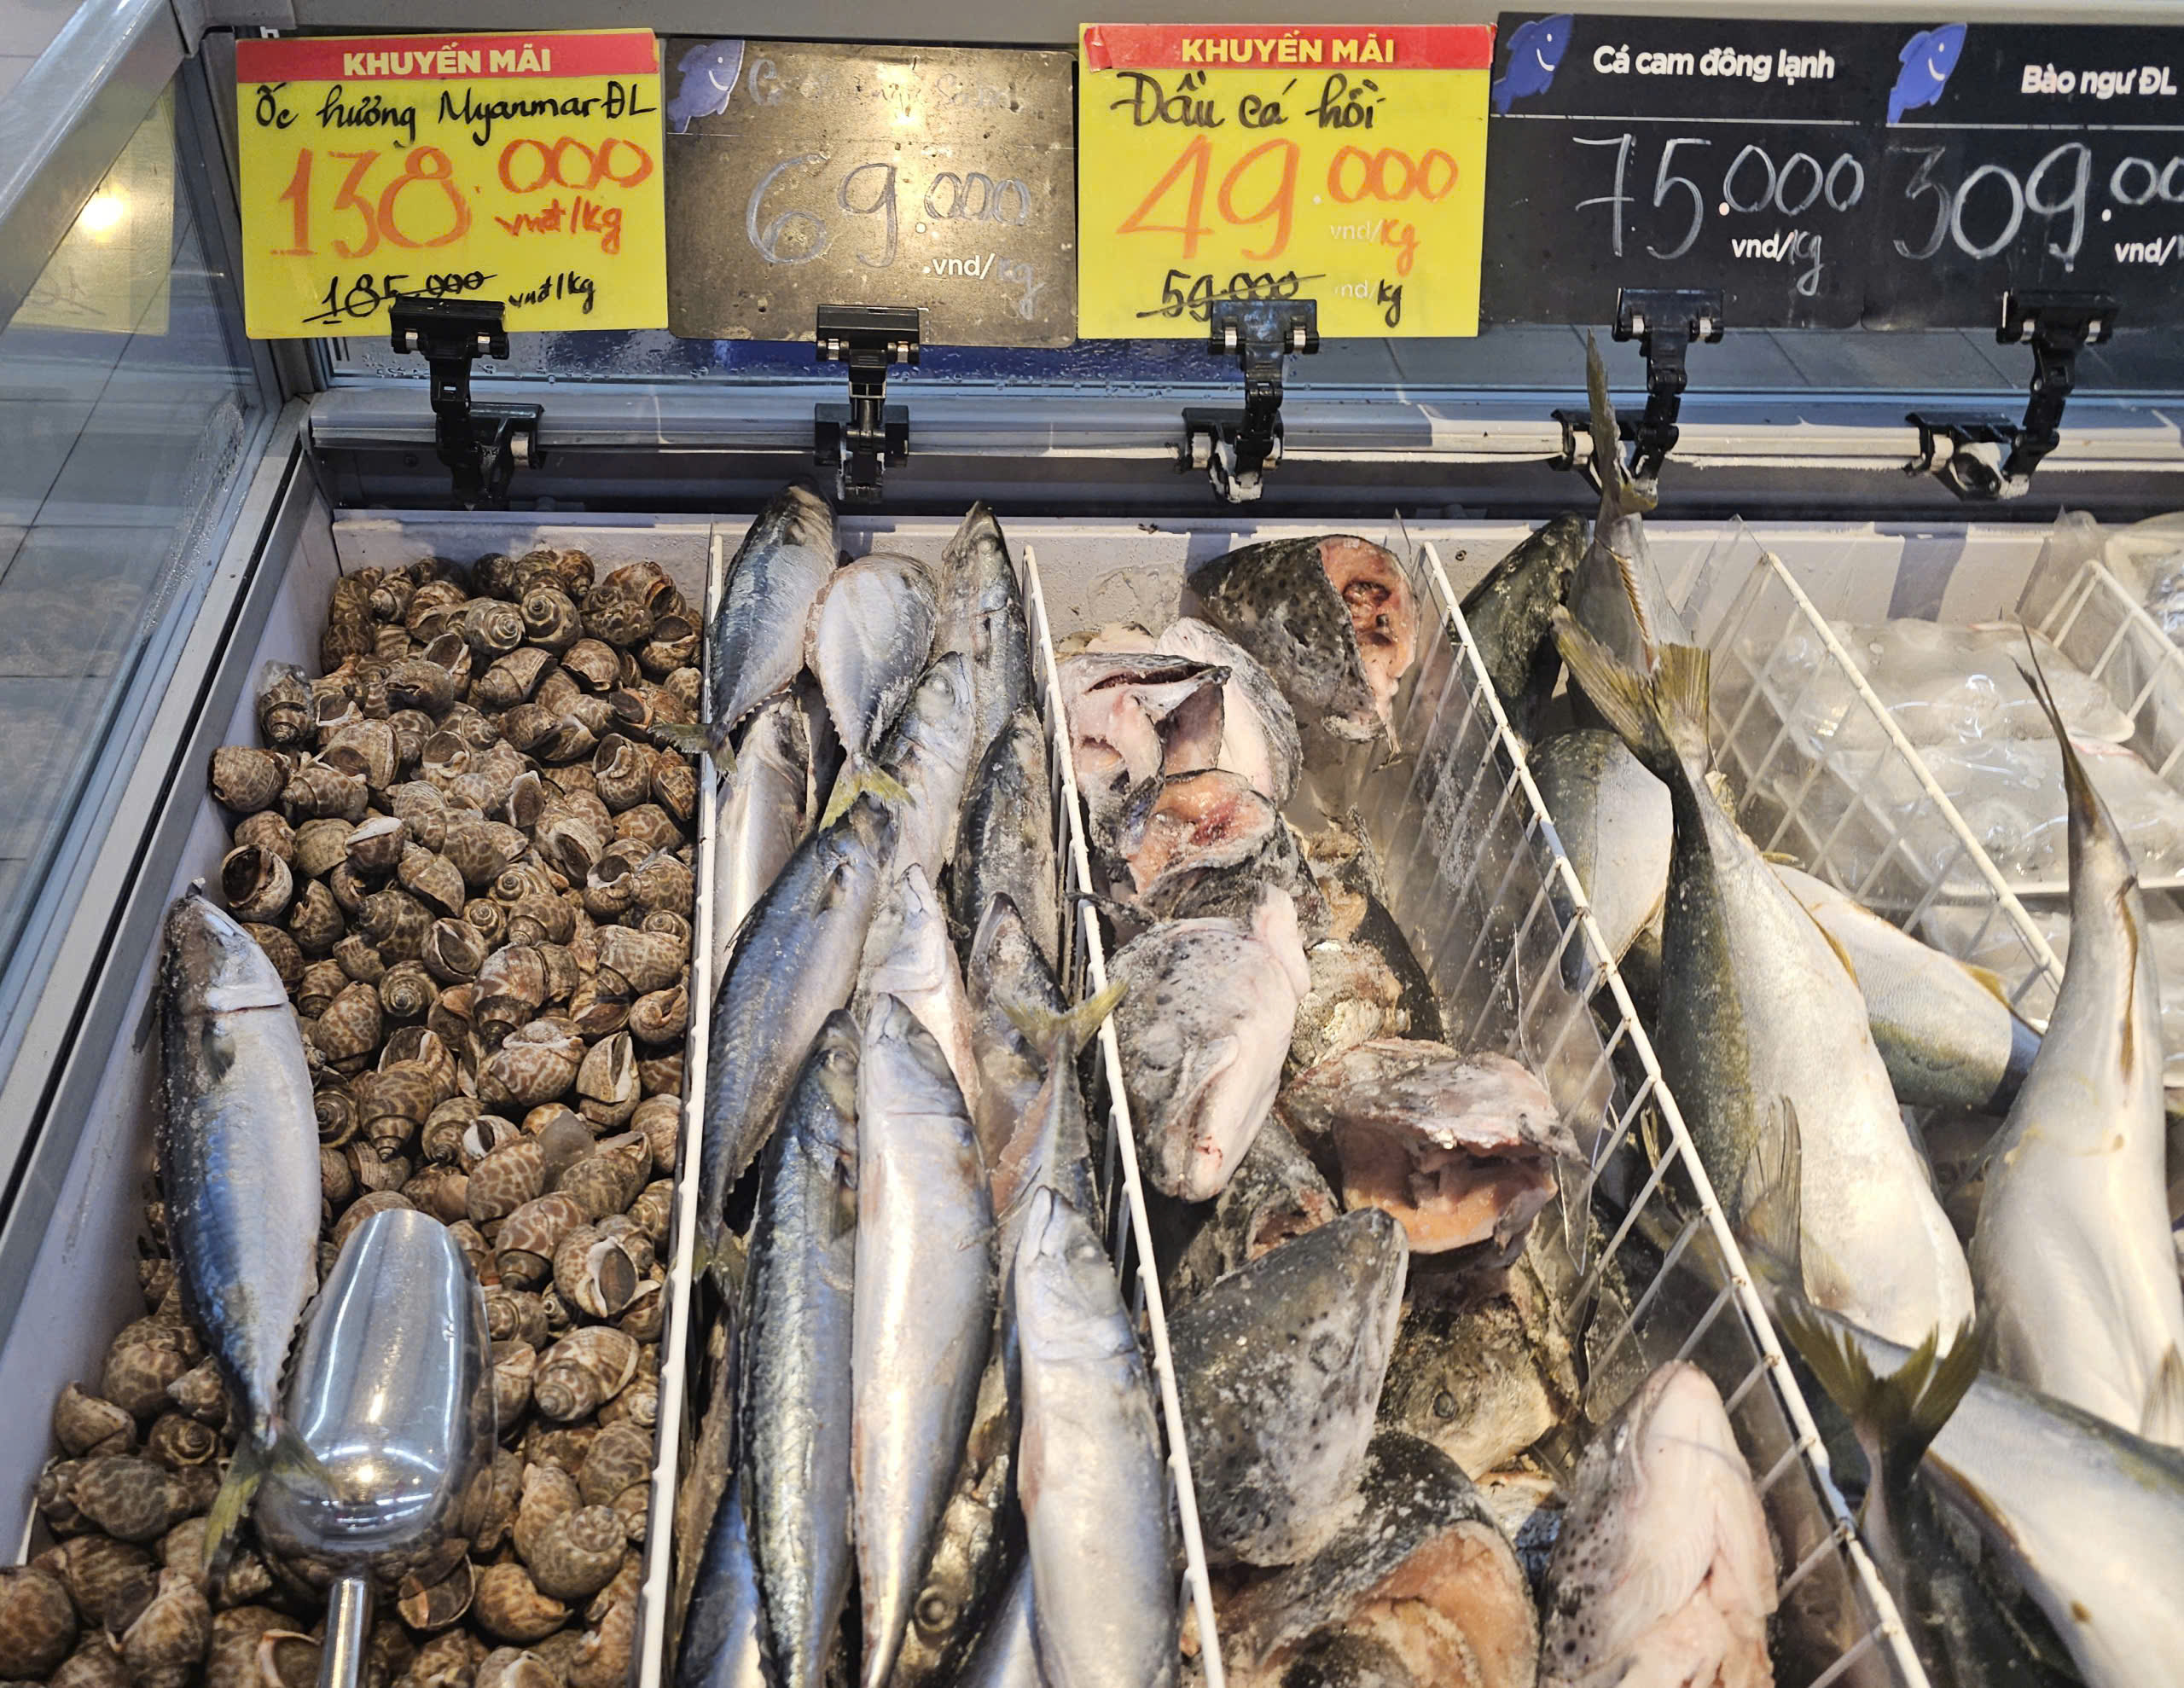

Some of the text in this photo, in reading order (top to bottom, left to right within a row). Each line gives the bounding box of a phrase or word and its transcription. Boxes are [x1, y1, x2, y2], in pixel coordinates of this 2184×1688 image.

[344, 42, 551, 76] KHUYẾN MÃI
[1182, 29, 1394, 63] KHUYẾN MÃI
[1593, 44, 1834, 85] Cá cam đông lạnh
[1239, 78, 1298, 128] cá
[1305, 73, 1385, 129] hồi
[2021, 62, 2178, 100] Bào ngư ĐL
[256, 83, 299, 129] Ốc
[438, 86, 602, 147] Myanmar
[601, 80, 658, 119] ĐL
[1115, 134, 1459, 260] 49.000
[1572, 134, 1865, 259] 75.000
